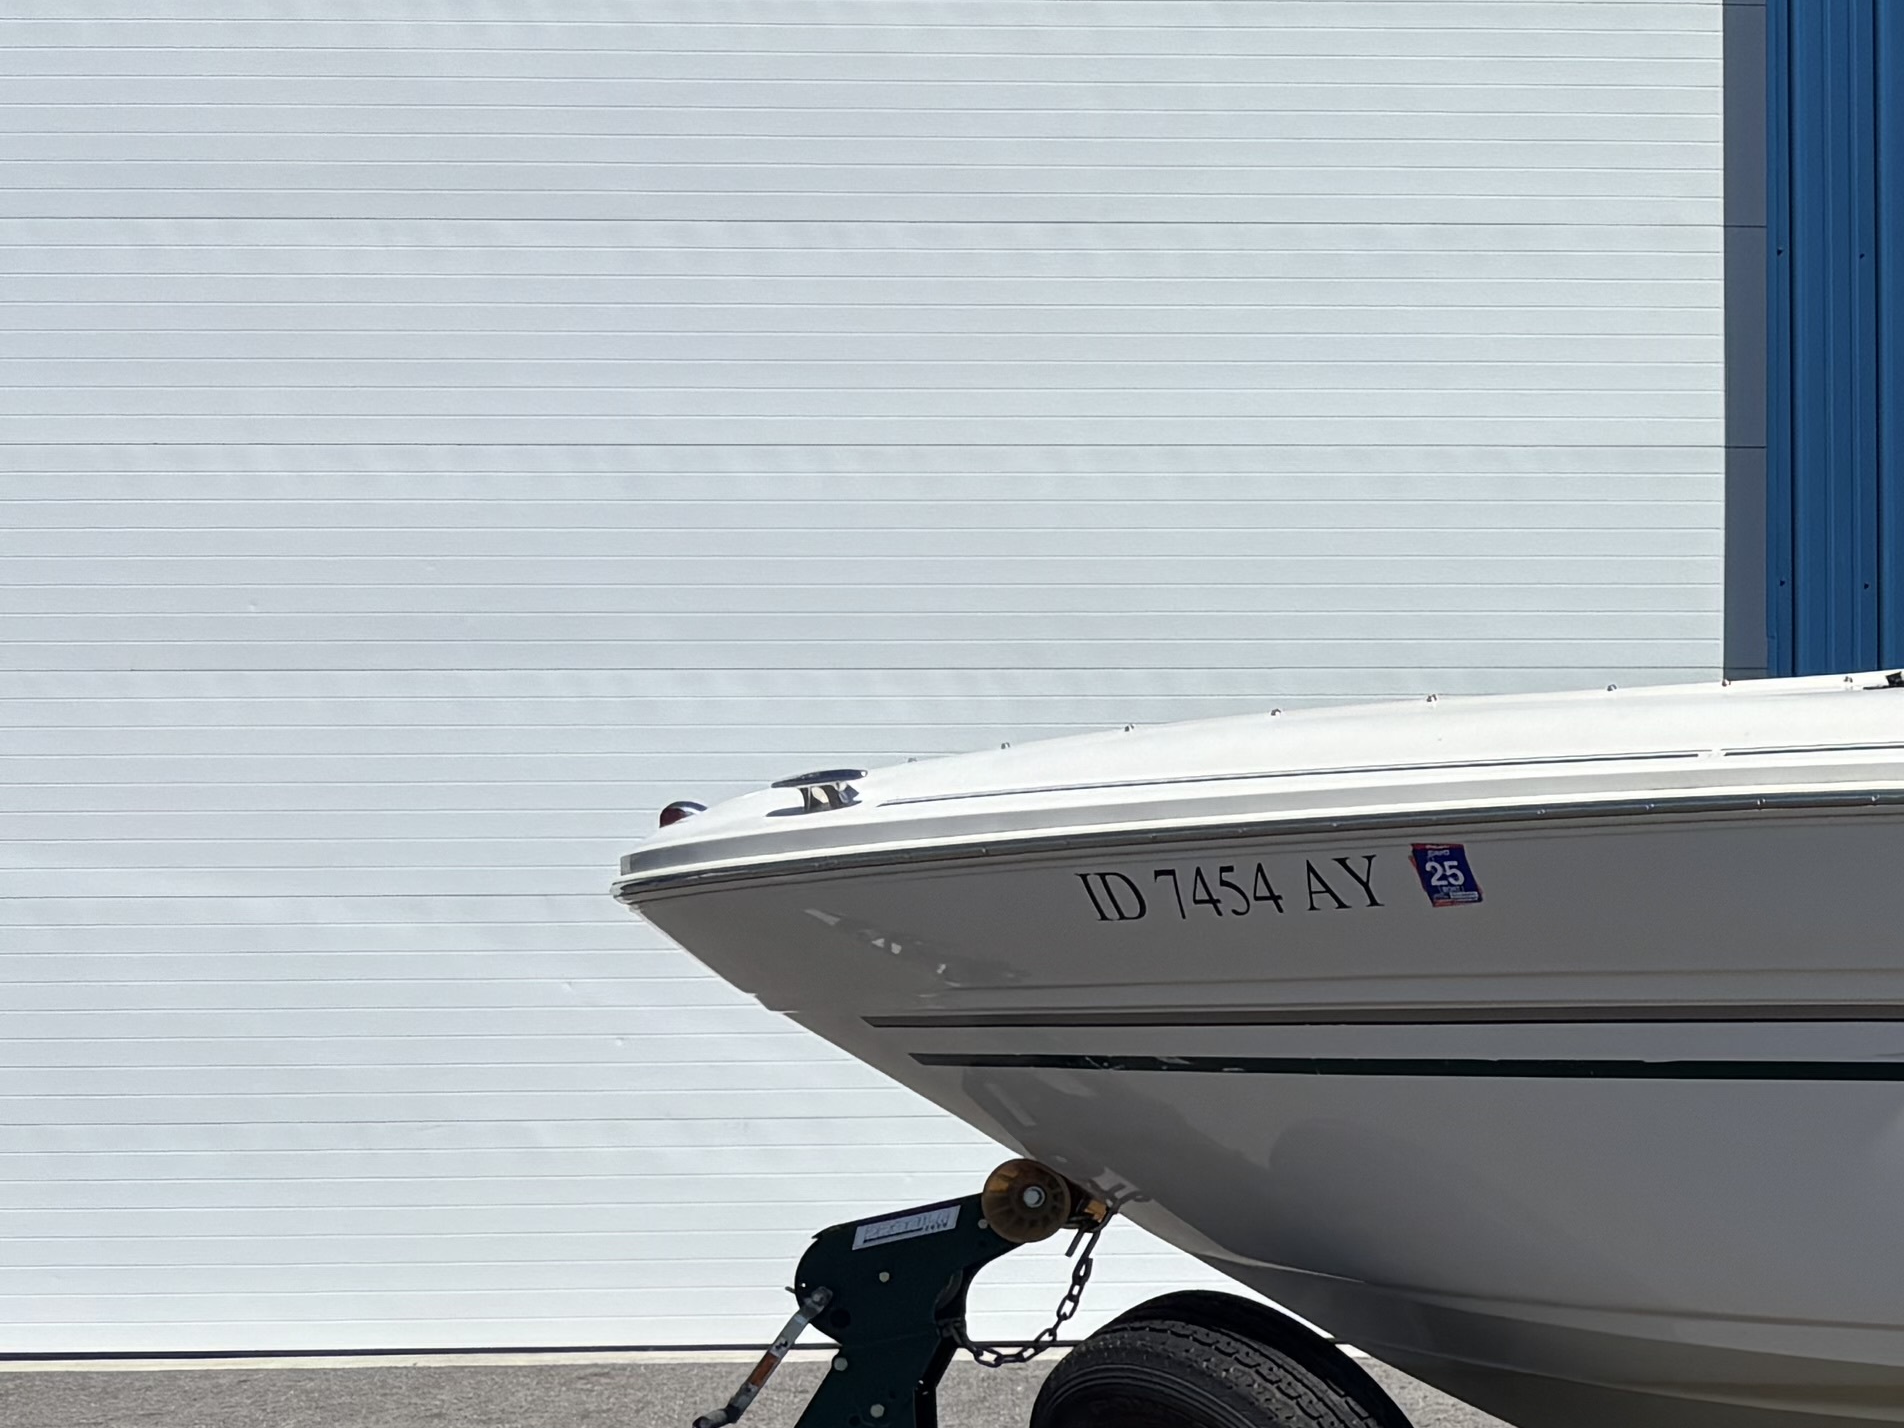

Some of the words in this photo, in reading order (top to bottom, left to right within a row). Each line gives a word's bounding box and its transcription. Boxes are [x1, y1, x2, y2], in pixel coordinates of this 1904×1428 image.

[1074, 871, 1148, 922] ID
[1153, 861, 1285, 920] 7454
[1304, 853, 1386, 912] AY
[1424, 860, 1466, 887] 25
